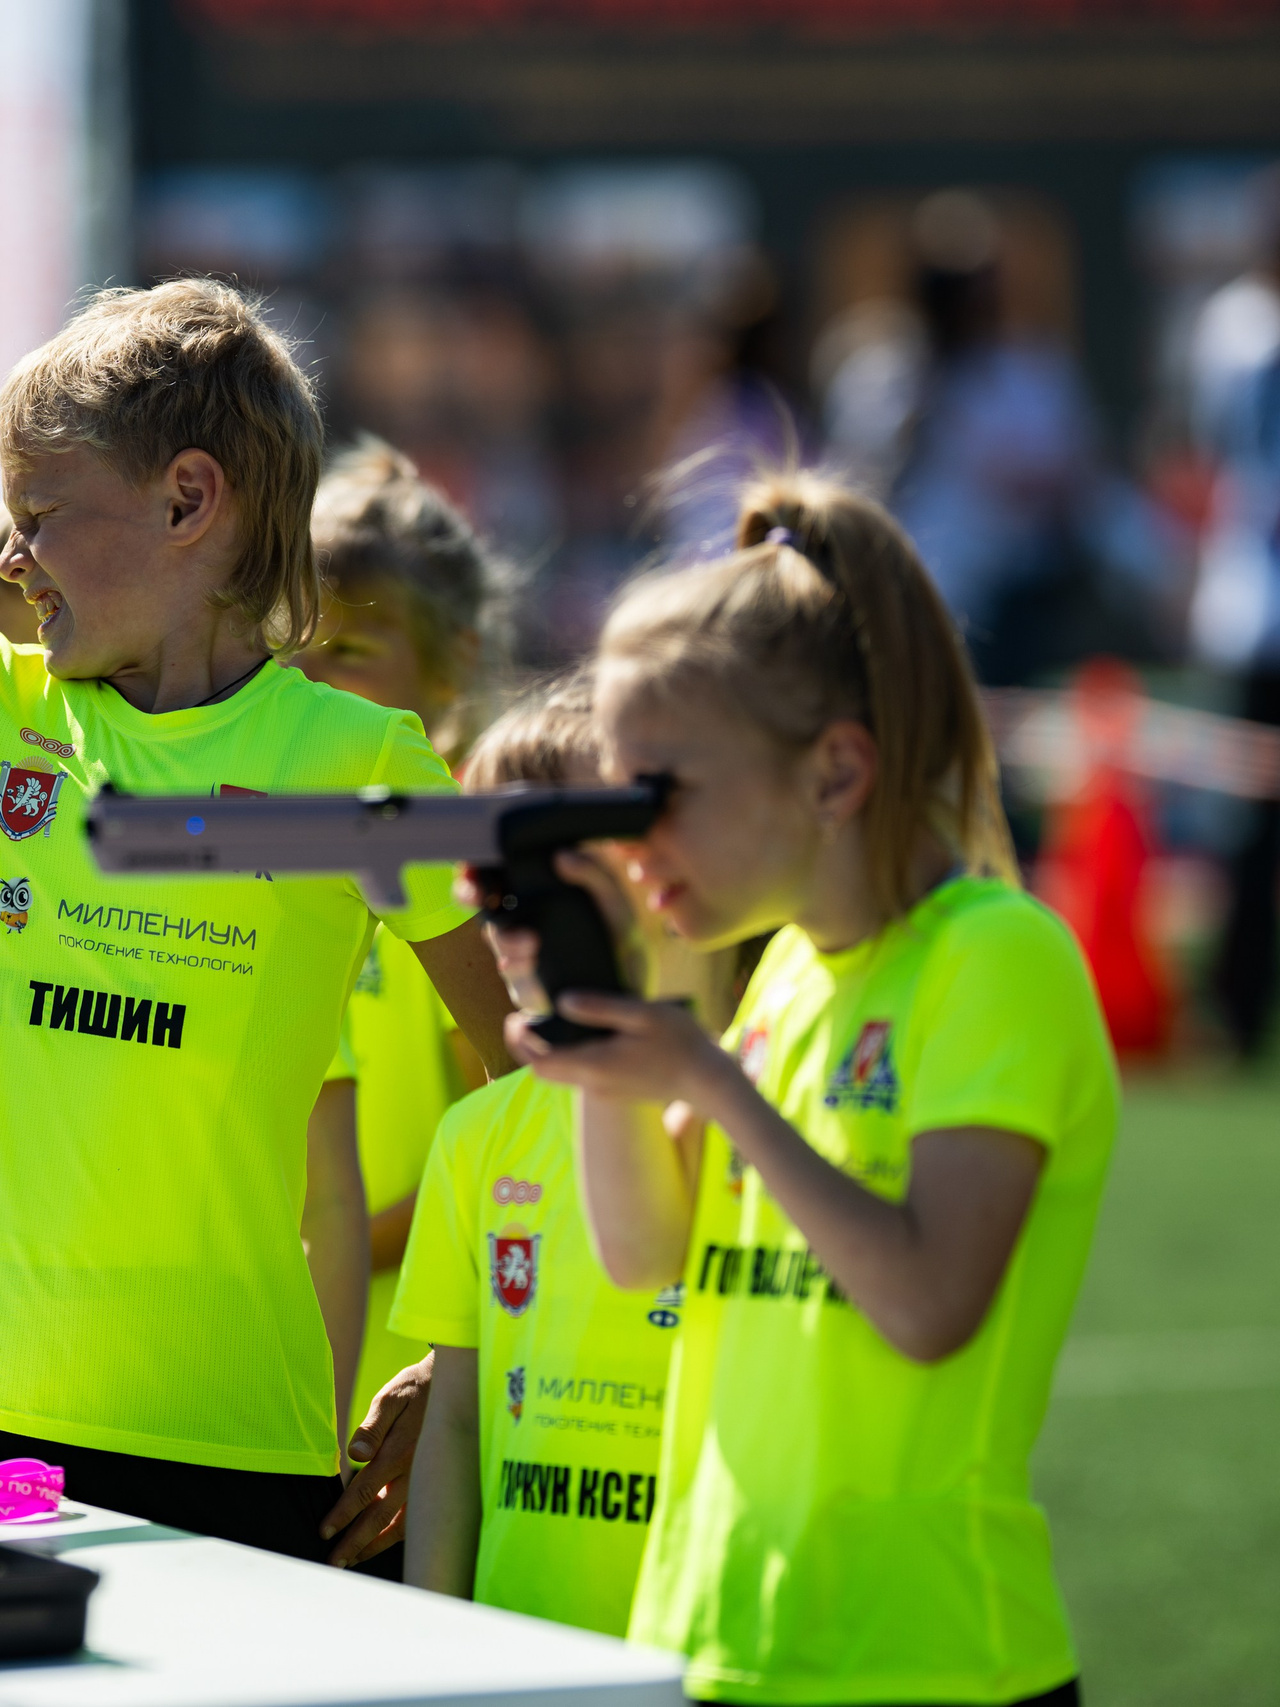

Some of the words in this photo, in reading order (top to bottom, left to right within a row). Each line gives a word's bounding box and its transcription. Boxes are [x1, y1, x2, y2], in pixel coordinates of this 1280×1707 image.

[57, 898, 257, 951] МИЛЛЕНИУМ
[58, 933, 145, 961] ПОКОЛЕНИЕ
[148, 949, 254, 976] ТЕХНОЛОГИЙ
[28, 979, 187, 1050] ТИШИН
